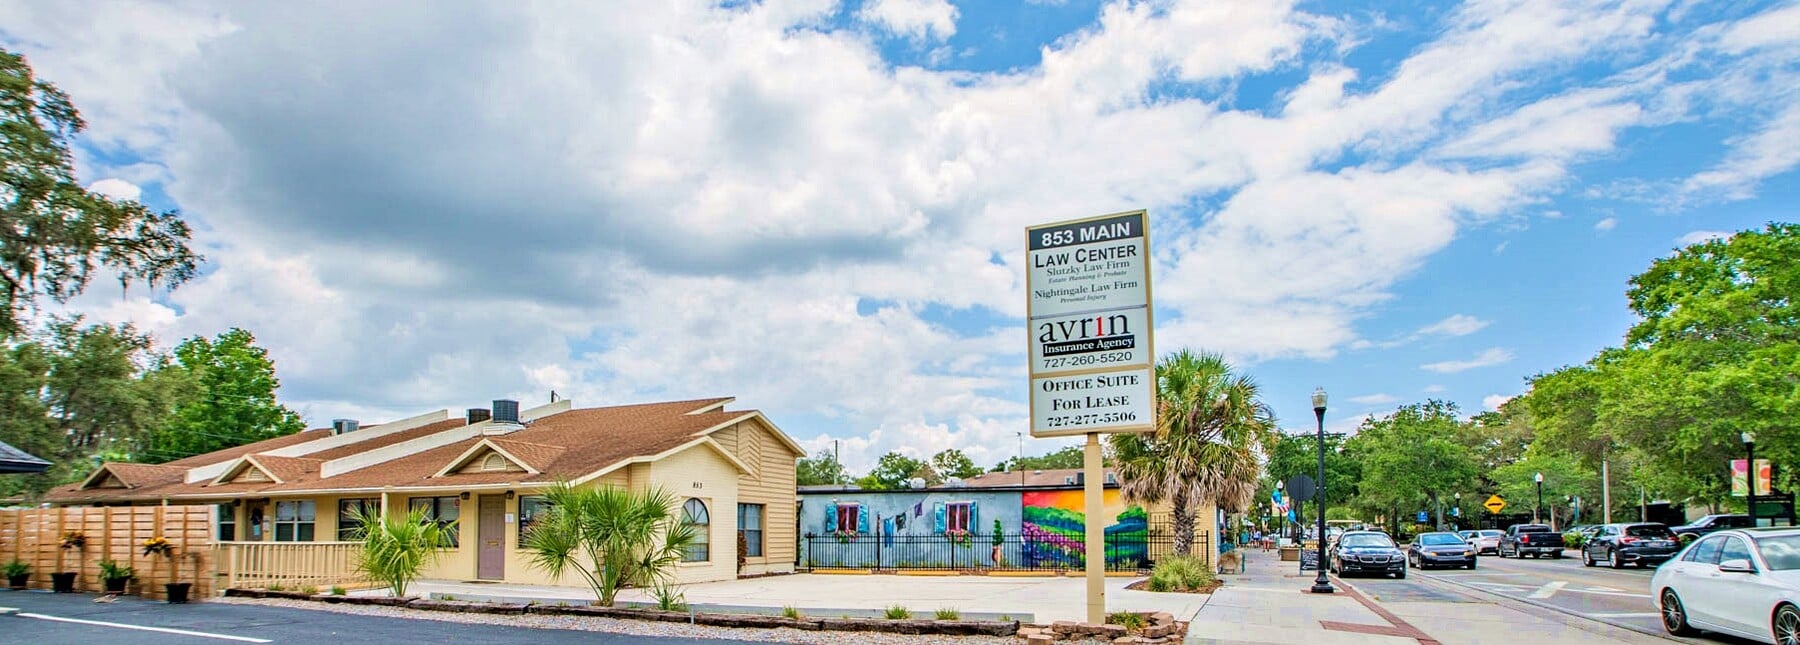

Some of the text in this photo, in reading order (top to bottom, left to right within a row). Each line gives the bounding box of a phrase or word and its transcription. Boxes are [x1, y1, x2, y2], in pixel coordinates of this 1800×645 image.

[1041, 222, 1130, 247] 853 MAIN
[1035, 244, 1137, 268] LAW CENTER
[1046, 260, 1130, 277] Slutzky Law Firm
[1069, 274, 1096, 282] Planning
[1035, 280, 1138, 299] Nightingale Law Firm
[1044, 338, 1133, 354] Insurance Agency
[1044, 351, 1132, 368] 727-260-5520
[1042, 375, 1139, 392] OFFICE SUITE
[1053, 395, 1129, 411] FOR LEASE
[1047, 411, 1136, 427] 727-277-5506
